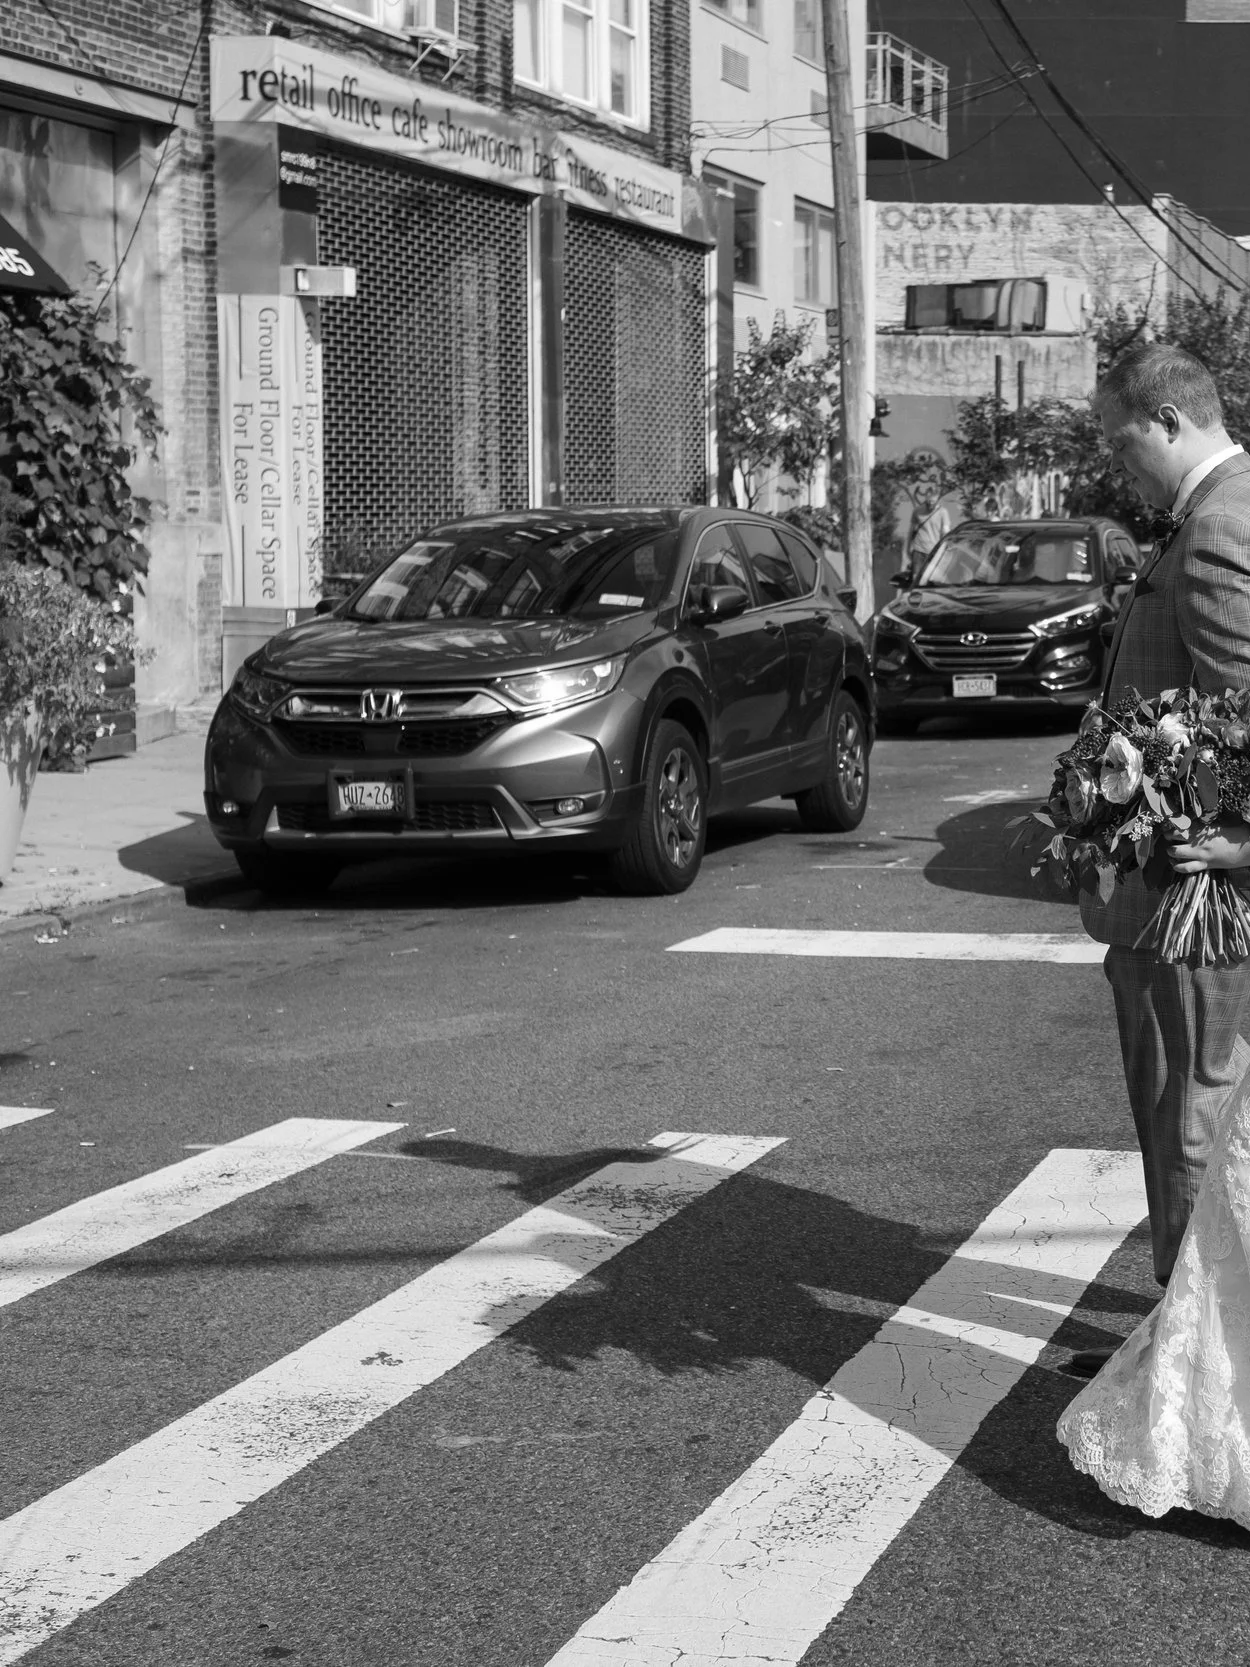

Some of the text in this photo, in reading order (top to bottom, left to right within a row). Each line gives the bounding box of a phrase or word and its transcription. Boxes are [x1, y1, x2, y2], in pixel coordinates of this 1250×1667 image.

[238, 64, 315, 112] retail
[327, 75, 382, 131] office
[392, 98, 429, 144] cafe
[437, 108, 524, 172] showroom
[532, 137, 558, 181] bar
[614, 176, 675, 218] restaurant
[0, 246, 35, 277] 85
[233, 403, 254, 505] For Lease
[256, 307, 281, 600] Ground Floor/Cellar Space
[292, 405, 305, 505] For Lease
